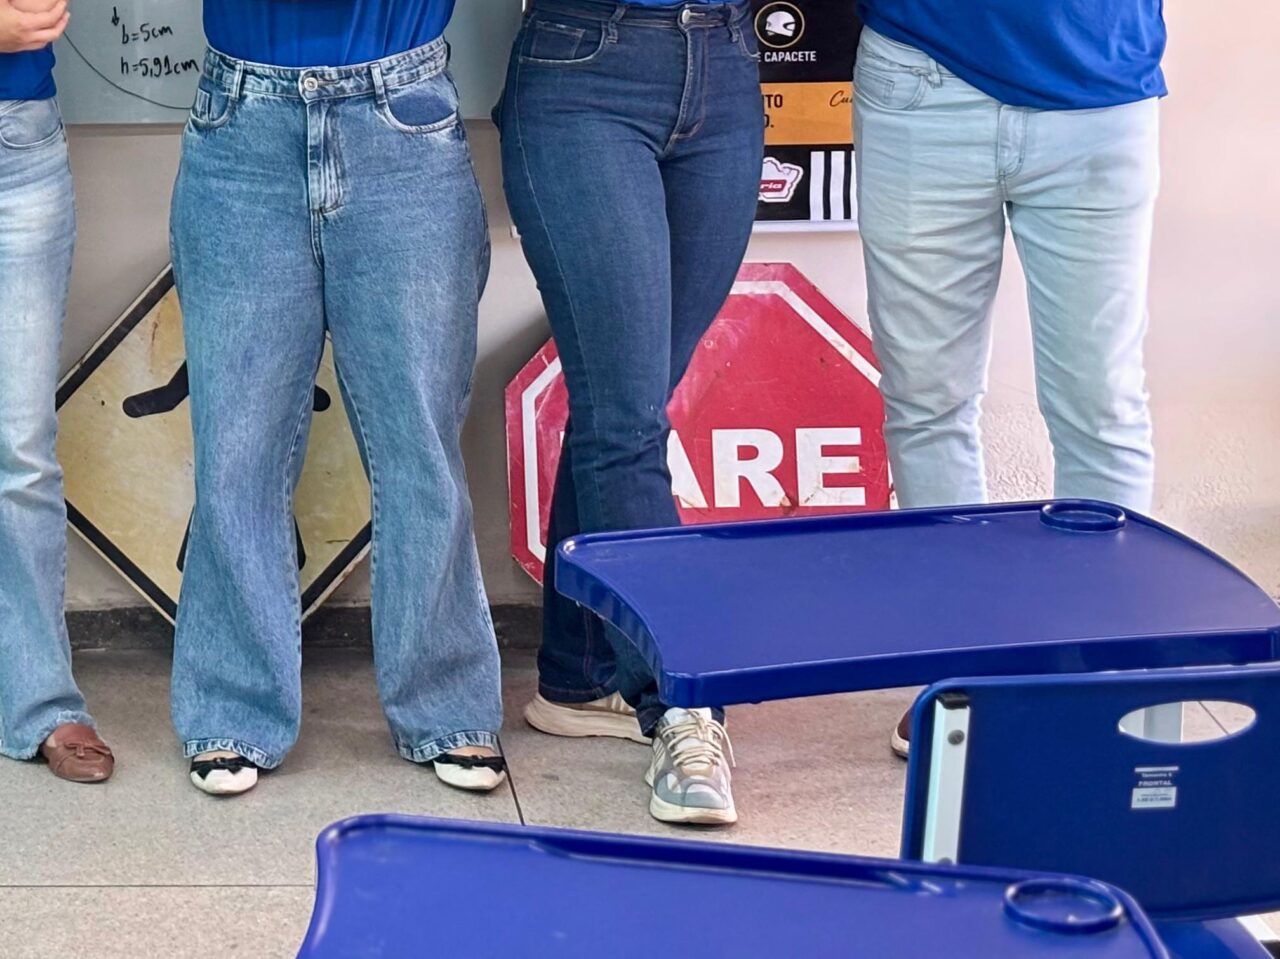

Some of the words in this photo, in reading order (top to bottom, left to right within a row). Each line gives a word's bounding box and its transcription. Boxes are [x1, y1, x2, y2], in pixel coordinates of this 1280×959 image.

[764, 51, 817, 62] CAPACETE
[760, 181, 782, 189] ria
[666, 427, 866, 509] ARE
